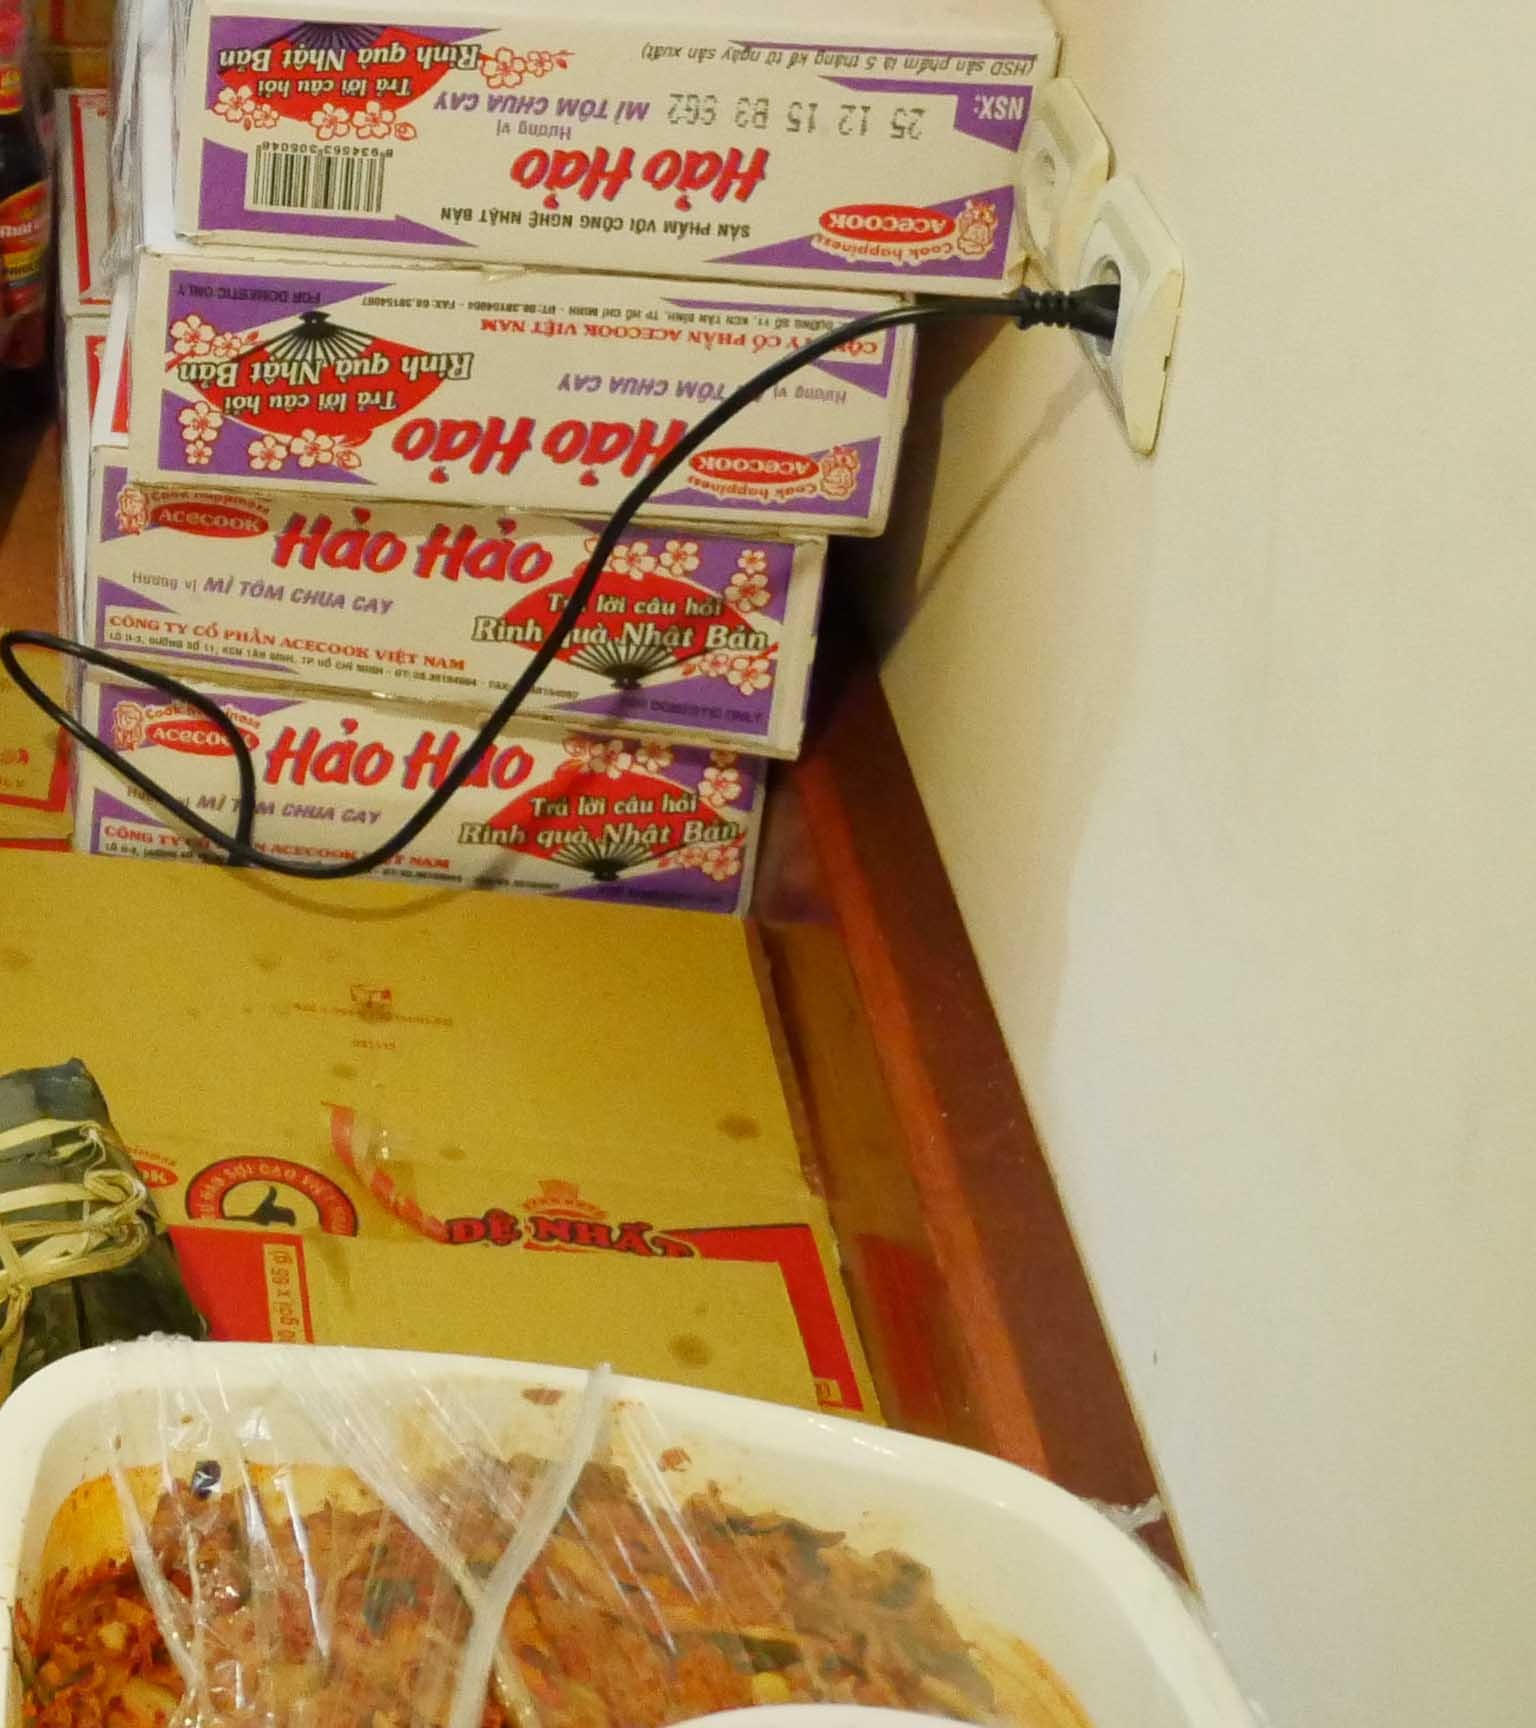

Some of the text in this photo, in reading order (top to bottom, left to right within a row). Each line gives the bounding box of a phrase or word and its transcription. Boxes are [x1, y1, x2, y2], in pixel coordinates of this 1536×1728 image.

[218, 47, 273, 74] Bản
[281, 43, 345, 73] Nhật
[356, 42, 408, 71] quà
[640, 42, 683, 64] xuất)
[686, 46, 717, 64] sản
[722, 44, 762, 66] ngày
[865, 55, 877, 71] 5
[883, 55, 899, 74] là
[902, 53, 951, 77] phẩm
[955, 58, 986, 76] sản
[989, 54, 1033, 76] (HSD
[257, 78, 412, 100] Trả lời câu hỏi
[431, 90, 650, 126] MÌ TÔM CHUA CAY
[785, 93, 1025, 141] NSX: 25 12 15
[496, 119, 573, 141] Hương vị
[510, 146, 770, 212] Hảo Hảo
[439, 206, 751, 242] SẢN PHẨM VỚI CÔNG NGHỆ NHẬT BẢN
[810, 232, 954, 262] Cook happiness
[479, 318, 782, 354] CỔ PHẦN ACECOOK VIỆT NAM
[176, 359, 239, 389] Bản
[249, 359, 324, 387] Nhật
[332, 352, 390, 384] quà
[557, 372, 603, 393] CAY
[608, 375, 669, 396] CHUA
[674, 380, 726, 404] TÔM
[223, 389, 398, 417] Trả lời câu hỏi
[391, 414, 688, 487] Hảo Hảo
[775, 482, 818, 500] Cook
[271, 506, 554, 585] Hảo Hảo
[239, 577, 284, 602] TÔM
[290, 586, 347, 610] CHUA
[352, 594, 396, 616] CAY
[633, 598, 677, 617] câu
[109, 612, 160, 632] CÔNG
[163, 620, 189, 635] TY
[279, 635, 369, 660] ACECOOK
[422, 655, 467, 672] NAM
[703, 622, 769, 652] Bản
[262, 716, 395, 788] Hảo
[612, 794, 655, 814] câu
